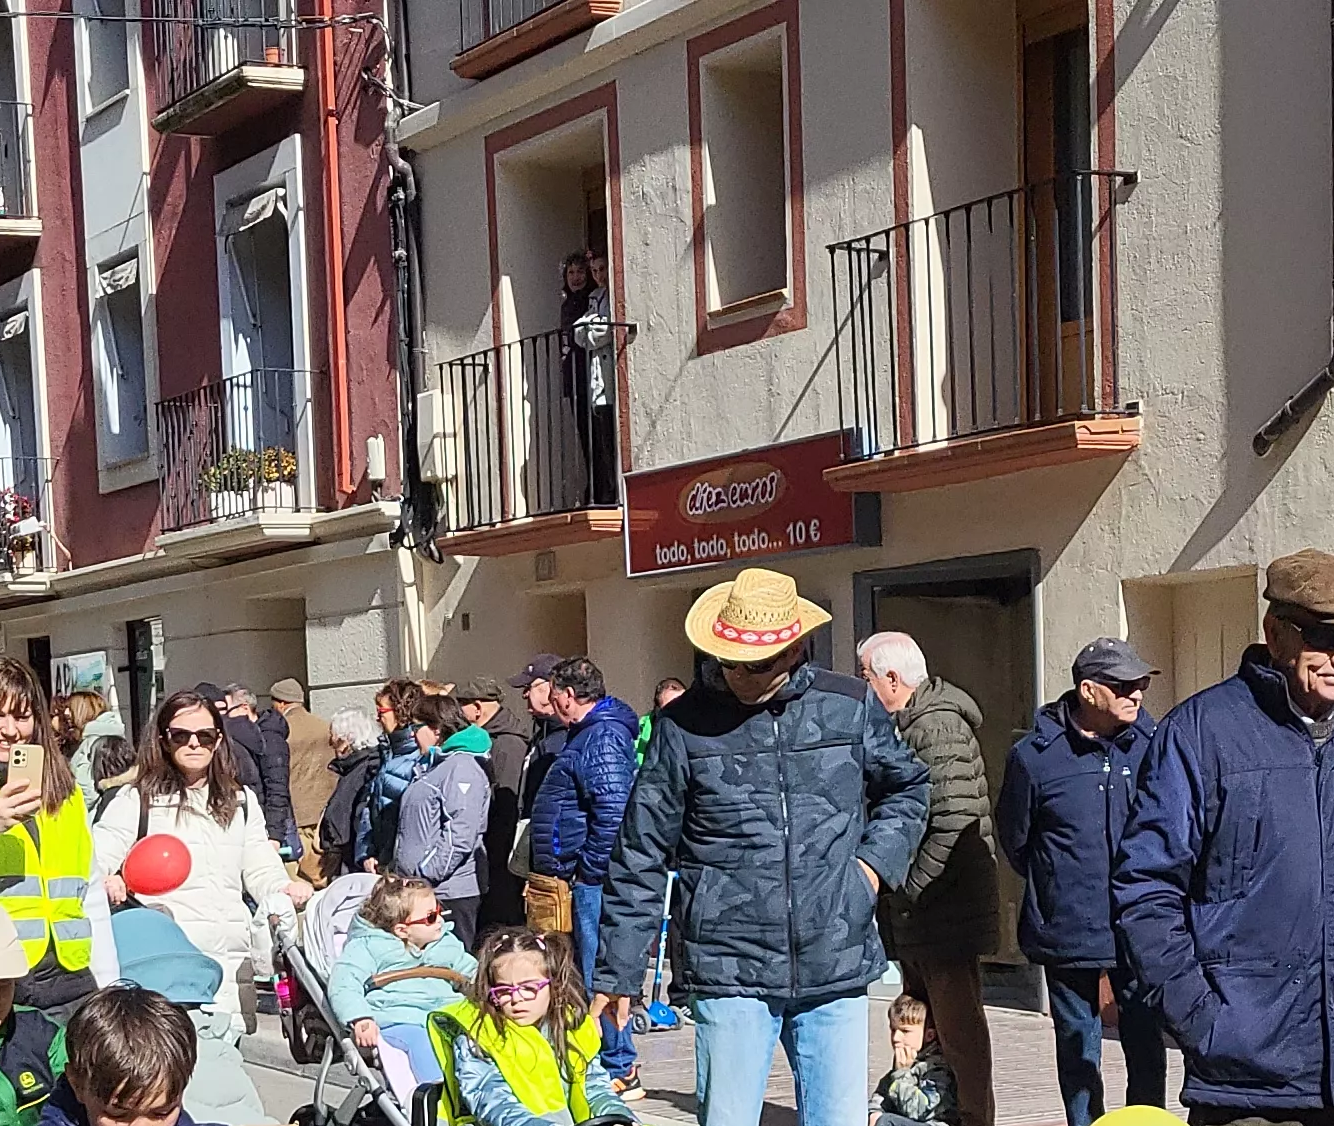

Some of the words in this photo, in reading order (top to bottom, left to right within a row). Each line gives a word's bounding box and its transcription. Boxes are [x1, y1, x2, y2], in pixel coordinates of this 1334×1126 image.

[687, 481, 728, 515] diez
[729, 471, 777, 508] euros
[656, 540, 691, 565] todo,
[694, 534, 731, 559] todo,
[734, 528, 783, 553] todo...
[786, 520, 806, 546] 10
[809, 518, 821, 542] €
